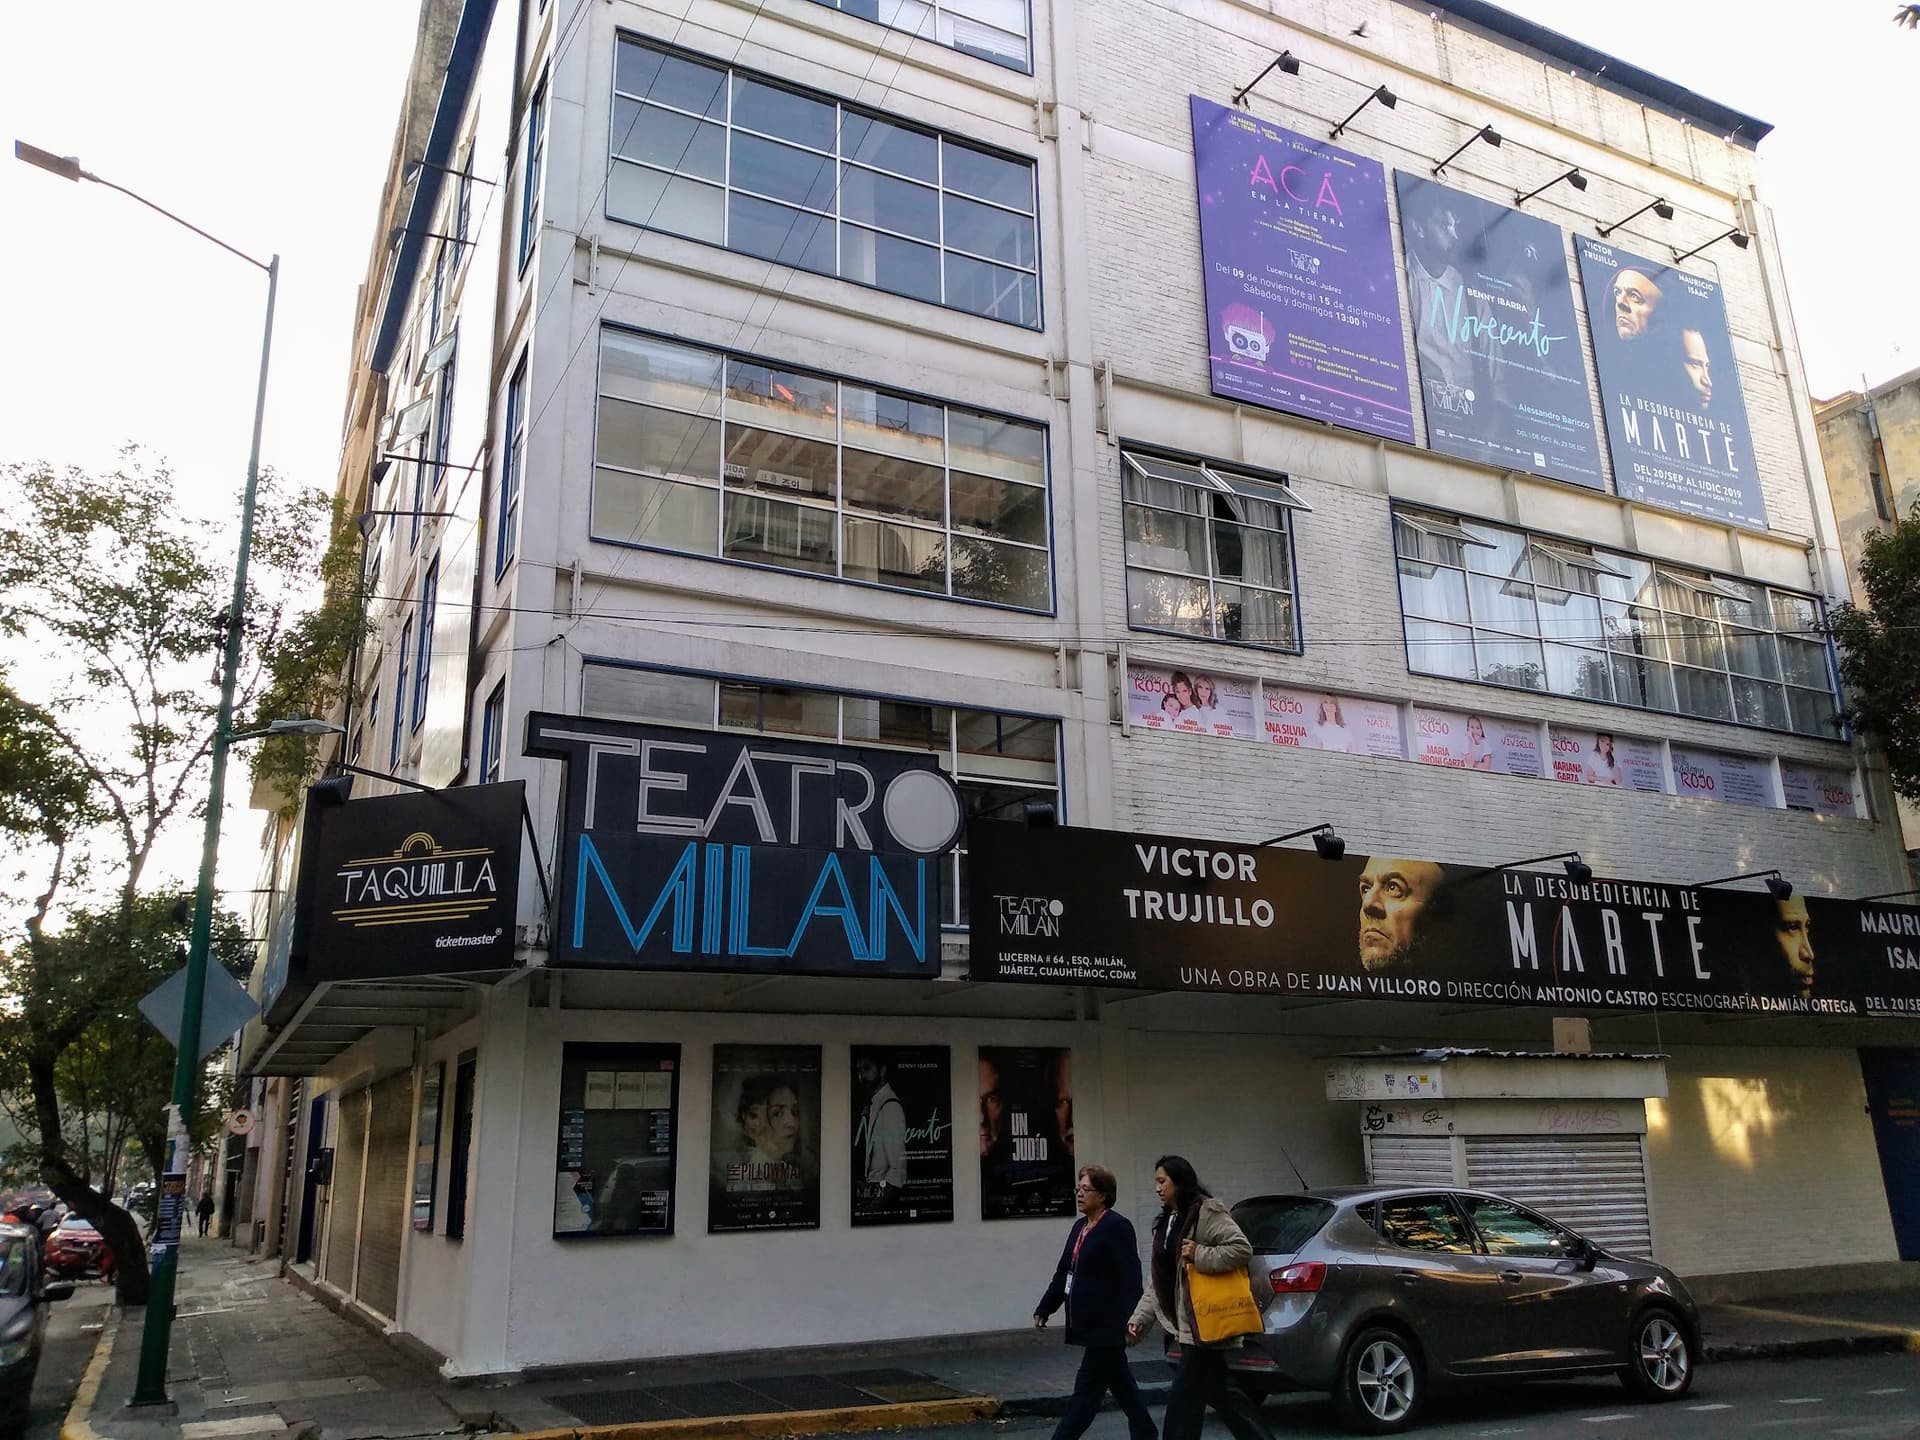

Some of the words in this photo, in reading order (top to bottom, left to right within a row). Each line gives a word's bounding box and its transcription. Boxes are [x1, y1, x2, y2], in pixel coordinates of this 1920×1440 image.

[1250, 153, 1343, 216] ACÁ
[1251, 190, 1266, 202] EN
[1276, 200, 1290, 210] LA
[1300, 207, 1344, 228] TIERRA
[1288, 248, 1320, 266] TEATRO
[1583, 250, 1618, 268] TRUJILLO
[1584, 240, 1613, 256] VICTOR
[1290, 261, 1319, 274] MILAN
[1216, 262, 1230, 274] Del
[1232, 268, 1244, 278] 09
[1247, 273, 1258, 283] de
[1260, 277, 1305, 298] noviembre
[1307, 290, 1316, 300] al
[1319, 295, 1330, 306] 15
[1333, 299, 1344, 310] de
[1347, 303, 1391, 324] diciembre
[1306, 277, 1318, 287] Col.
[1678, 273, 1714, 291] MAURICIO
[1687, 286, 1709, 299] ISAAC
[1243, 282, 1281, 302] Sábados
[1284, 296, 1289, 305] y
[1292, 296, 1333, 318] domingos
[1336, 312, 1360, 326] 13:00
[1362, 318, 1368, 328] h
[1467, 288, 1495, 302] BENNY
[1498, 298, 1528, 313] IBARRA
[1430, 284, 1568, 358] Novecento
[1432, 392, 1474, 416] MILAN
[1519, 403, 1560, 421] Alessandro
[1562, 415, 1590, 429] Baricco
[1619, 393, 1632, 406] LA
[1637, 398, 1715, 431] DESOBEDIENCIA
[1720, 422, 1733, 435] DE
[1621, 407, 1738, 472] MARTE
[1633, 463, 1651, 475] DEL
[1653, 468, 1684, 482] 20/SEP
[1686, 478, 1697, 487] AL
[1699, 480, 1721, 493] 1/DIC
[1724, 486, 1741, 499] 2019
[1135, 676, 1170, 695] ROJO
[1270, 698, 1302, 714] ROJO
[1265, 721, 1281, 734] ANA
[1282, 724, 1307, 737] SILVIA
[1420, 720, 1449, 735] ROJO
[1272, 734, 1299, 746] GARZA
[1552, 739, 1580, 753] ROJO
[1553, 760, 1583, 773] MARIANA
[539, 728, 961, 854] TEATRO
[1681, 772, 1714, 790] ROJO
[1134, 844, 1257, 882] VICTOR
[336, 857, 497, 903] TAQUILLA
[573, 831, 926, 963] MILAN
[1503, 874, 1524, 896] LA
[1536, 876, 1671, 909] DESOBEDIENCIA
[1680, 890, 1700, 911] DE
[993, 895, 1064, 917] TEATRO
[1123, 889, 1275, 928] TRUJILLO
[1000, 913, 1059, 937] MILAN
[435, 935, 497, 948] ticketmaster
[1506, 900, 1711, 980] MARTE
[999, 952, 1044, 964] LUCERNA
[1053, 955, 1064, 965] 64
[1071, 956, 1092, 967] ESQ.
[1094, 956, 1126, 968] MILÁN,
[999, 964, 1038, 977] JUÁREZ,
[1110, 969, 1137, 980] CDMX
[1180, 967, 1222, 986] UNA
[1228, 970, 1280, 989] OBRA
[1287, 972, 1310, 990] DE
[1316, 974, 1362, 993] JUAN
[1368, 977, 1441, 996] VILLORO
[1447, 980, 1532, 1000] DIRECCIÓN
[1536, 985, 1601, 1004] ANTONIO
[1606, 989, 1658, 1006] CASTRO
[1662, 992, 1760, 1010] ESCENOGRAFÍA
[1761, 994, 1809, 1012] DAMIÁN
[1812, 998, 1856, 1014] ORTEGA
[1866, 996, 1888, 1010] DEL
[1011, 1112, 1028, 1136] UN
[1012, 1133, 1047, 1161] JUDÍO
